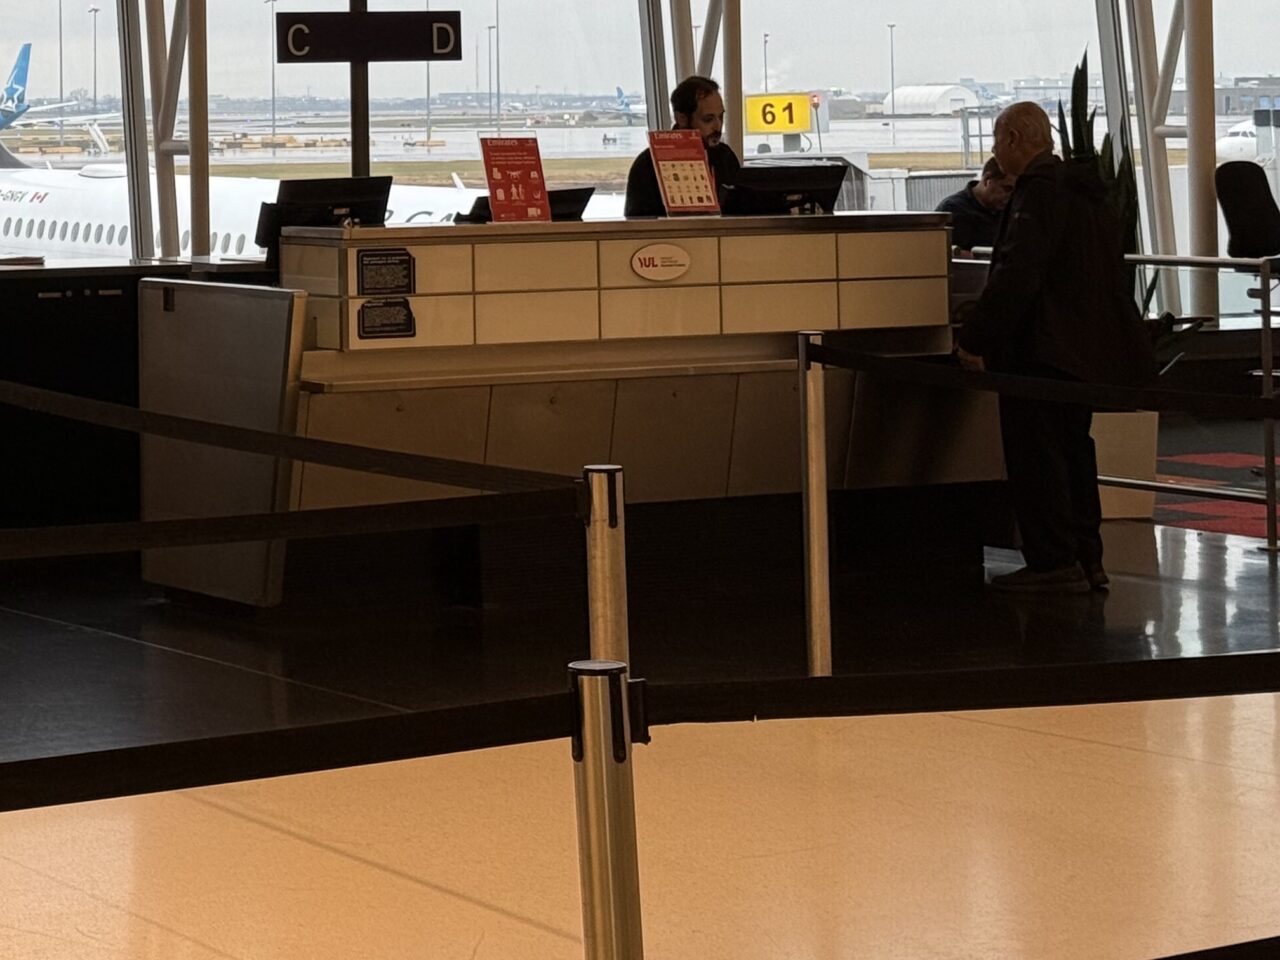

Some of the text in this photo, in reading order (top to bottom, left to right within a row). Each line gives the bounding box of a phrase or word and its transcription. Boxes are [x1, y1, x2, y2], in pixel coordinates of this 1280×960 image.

[287, 23, 455, 56] C D
[762, 102, 794, 125] 61
[637, 256, 658, 268] YUL
